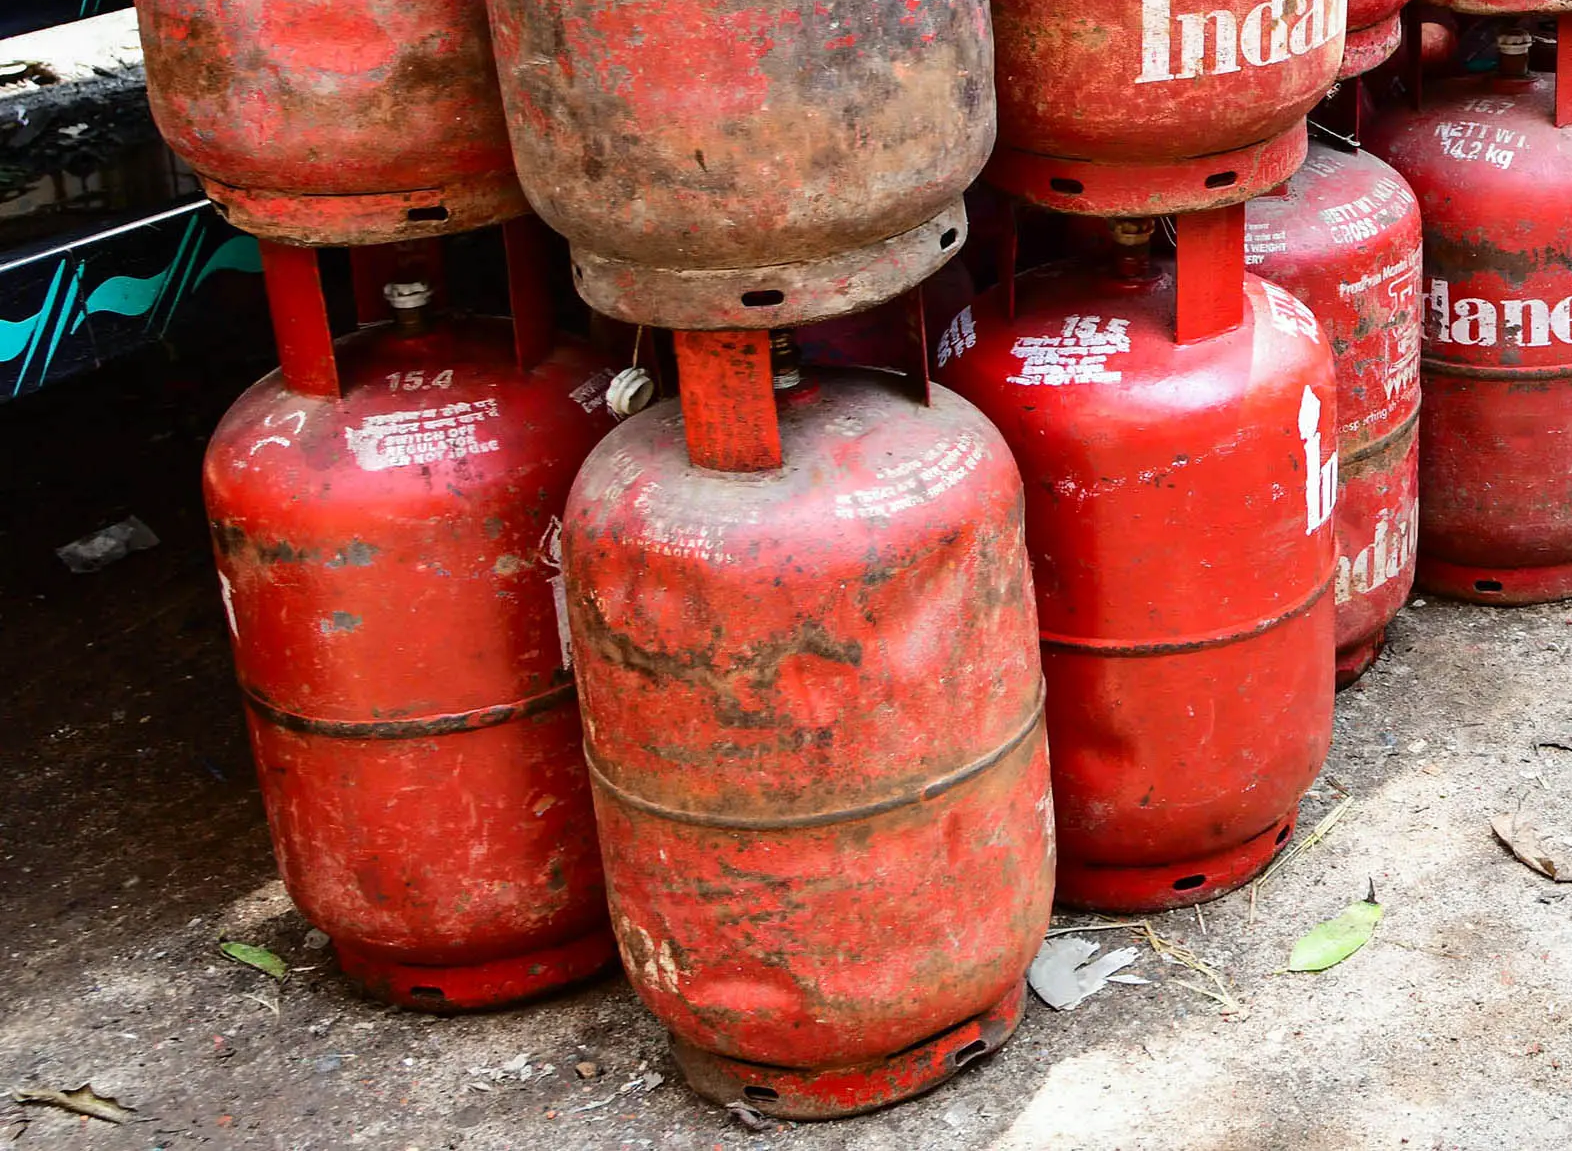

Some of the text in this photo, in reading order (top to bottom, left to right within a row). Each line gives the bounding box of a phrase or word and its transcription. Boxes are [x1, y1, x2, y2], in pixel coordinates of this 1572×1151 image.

[1435, 121, 1492, 140] NETT
[1485, 142, 1515, 170] kg
[1251, 242, 1287, 254] WEIGHT
[385, 369, 455, 392] 15.4
[384, 424, 477, 447] SWITCH OFF
[414, 450, 444, 465] NOT
[469, 440, 500, 455] USE
